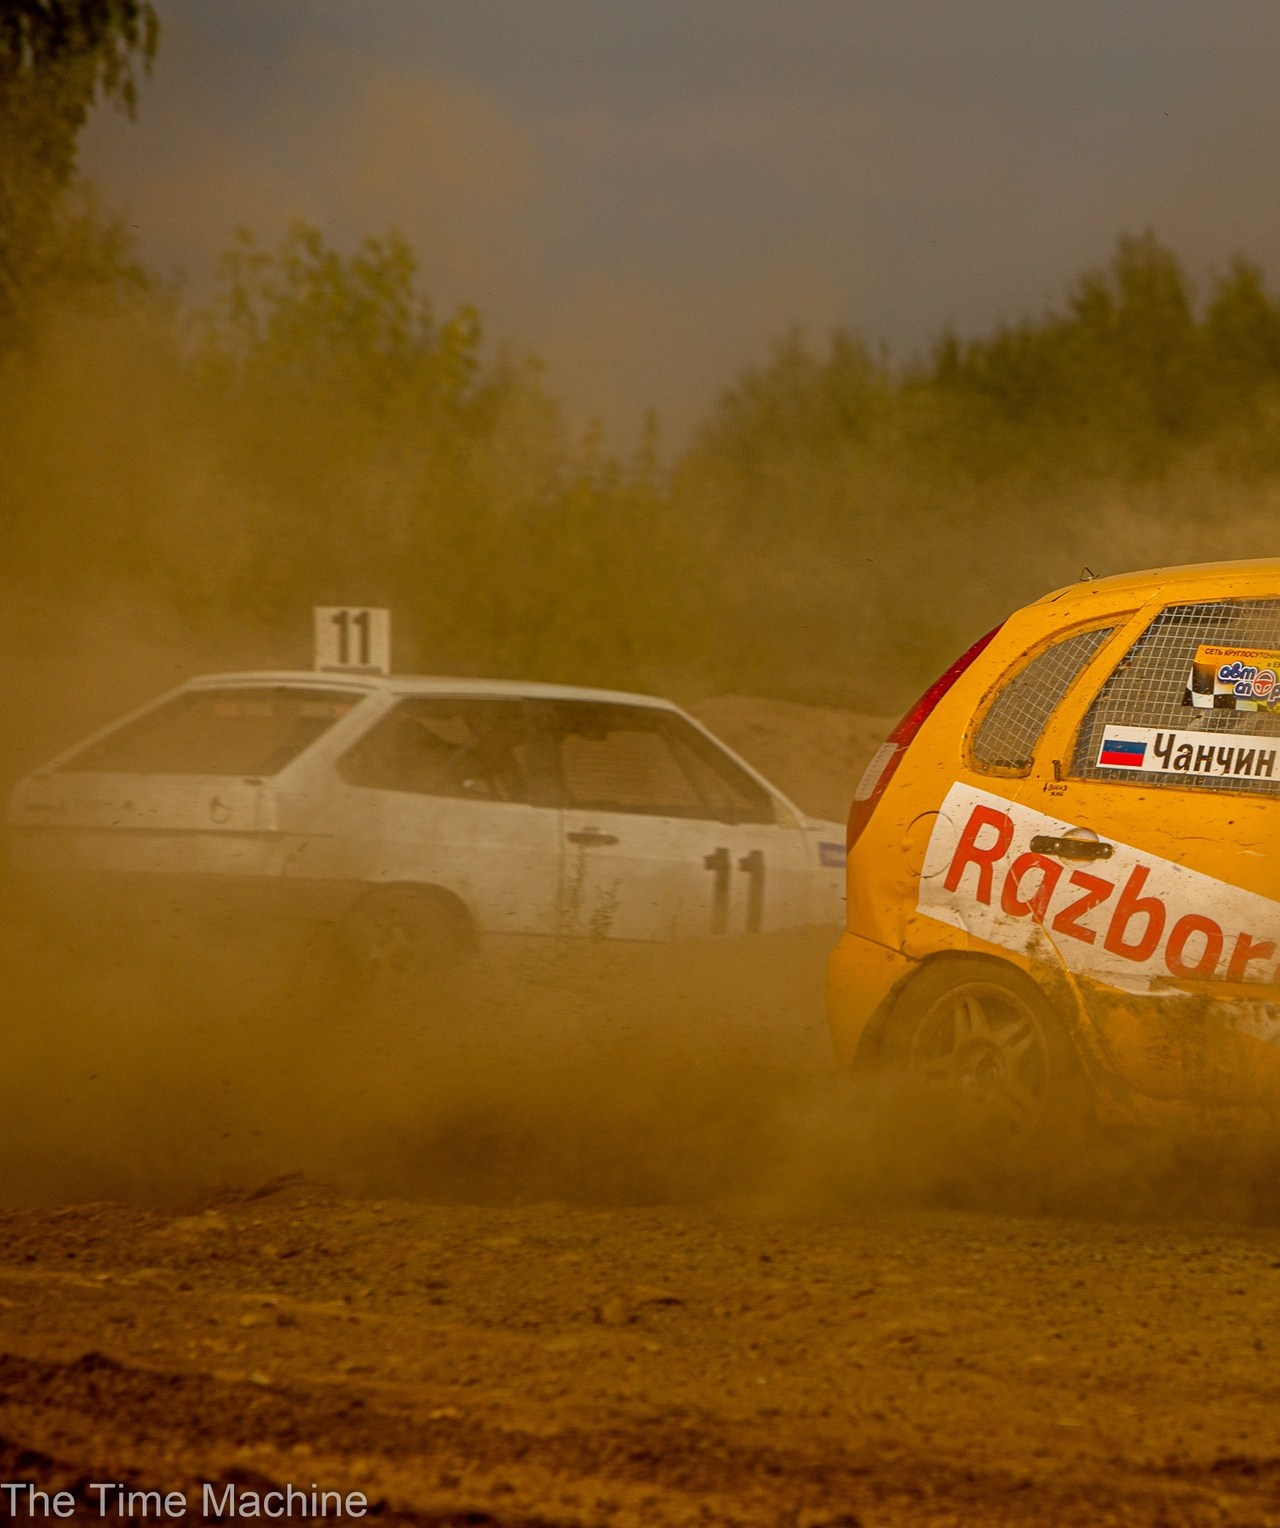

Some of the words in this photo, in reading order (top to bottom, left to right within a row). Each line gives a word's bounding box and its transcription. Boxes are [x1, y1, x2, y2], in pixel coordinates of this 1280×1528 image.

[331, 610, 370, 665] 11
[1204, 648, 1223, 656] СЕТЬ
[1153, 732, 1277, 777] Чанчин
[704, 847, 765, 935] 11
